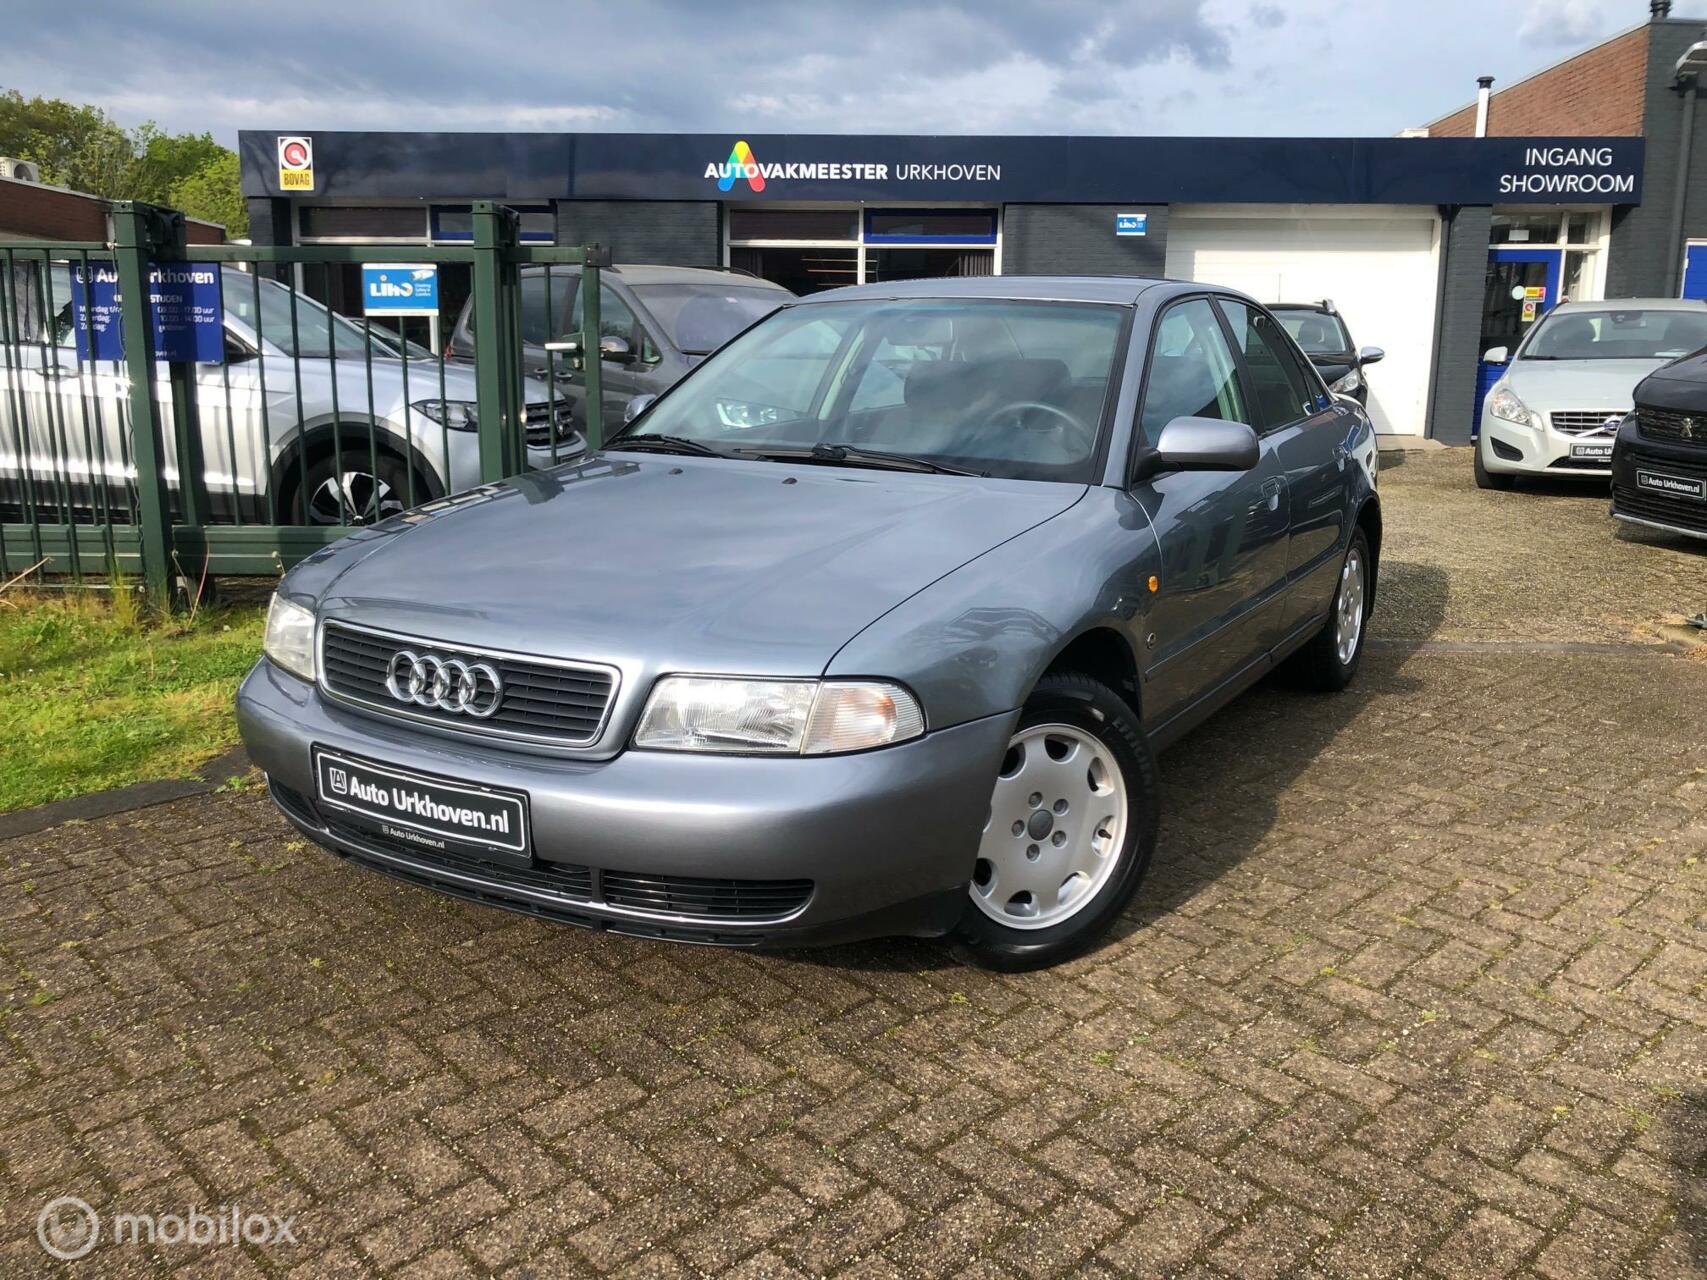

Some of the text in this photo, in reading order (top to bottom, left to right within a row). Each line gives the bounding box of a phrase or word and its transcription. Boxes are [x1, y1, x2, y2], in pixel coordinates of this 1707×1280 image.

[1525, 147, 1613, 166] INGANG
[284, 173, 310, 186] BOVAG
[704, 162, 1001, 181] AUTOVAKMEESTER URKHOVEN
[1499, 174, 1634, 193] SHOWROOM
[149, 268, 214, 284] rkhoven
[1585, 447, 1603, 455] Auto
[1648, 477, 1700, 493] Auto Urkhoven.nl
[350, 776, 389, 806] Auto
[392, 788, 509, 833] Urkhoven.nl
[390, 828, 445, 849] Auto Urkhoven.nl
